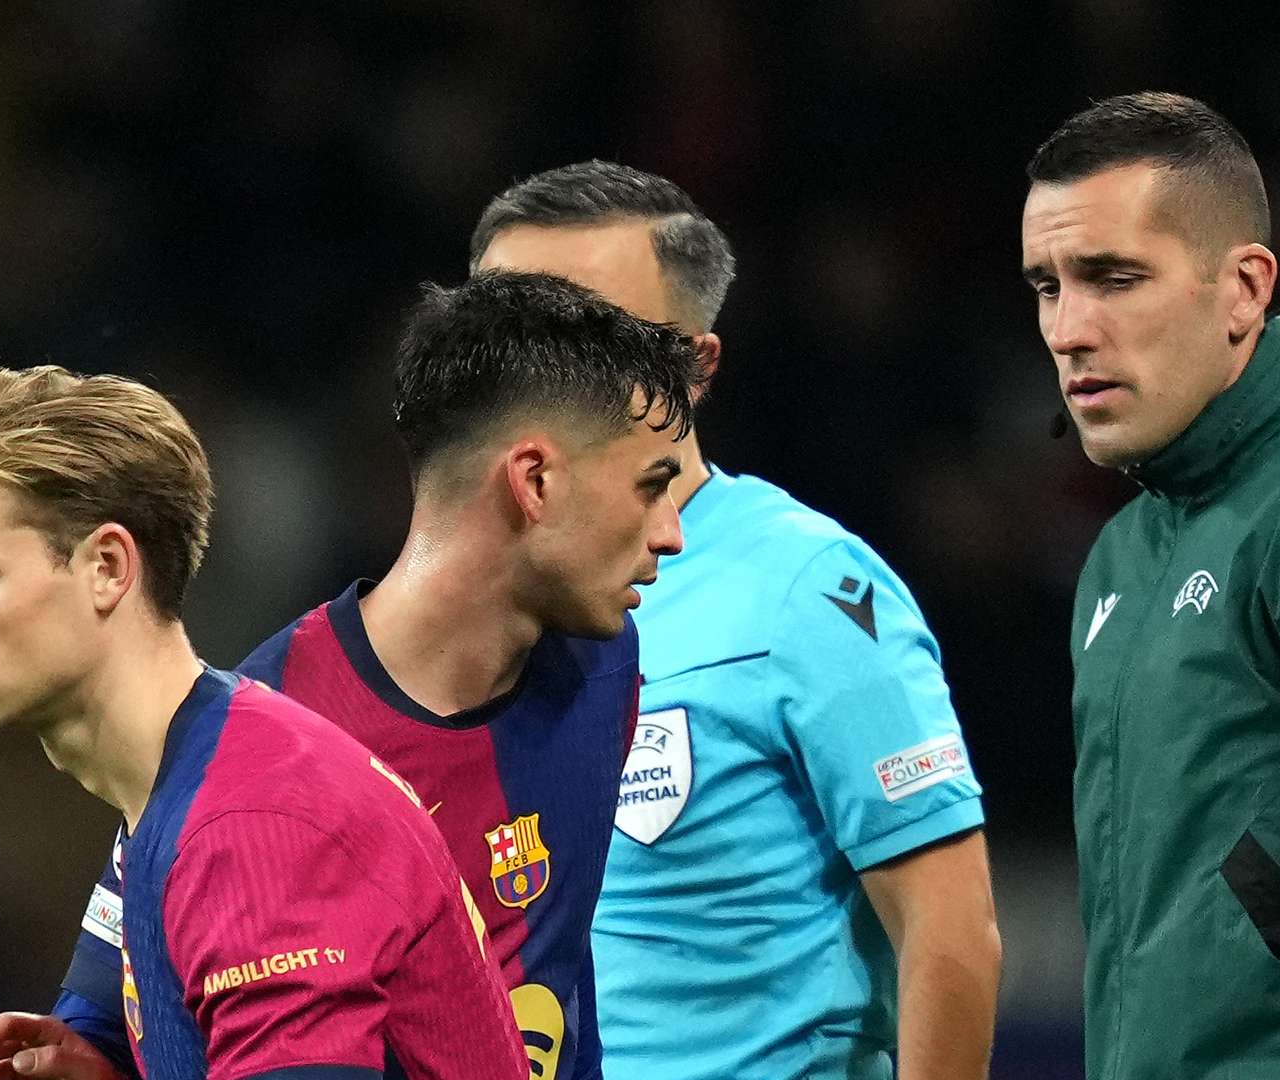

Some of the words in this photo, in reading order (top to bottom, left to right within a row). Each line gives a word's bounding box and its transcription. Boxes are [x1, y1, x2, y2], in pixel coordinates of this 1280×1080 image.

[1173, 575, 1213, 610] UEFA
[204, 948, 319, 997] AMBILIGHT
[324, 947, 345, 964] tv
